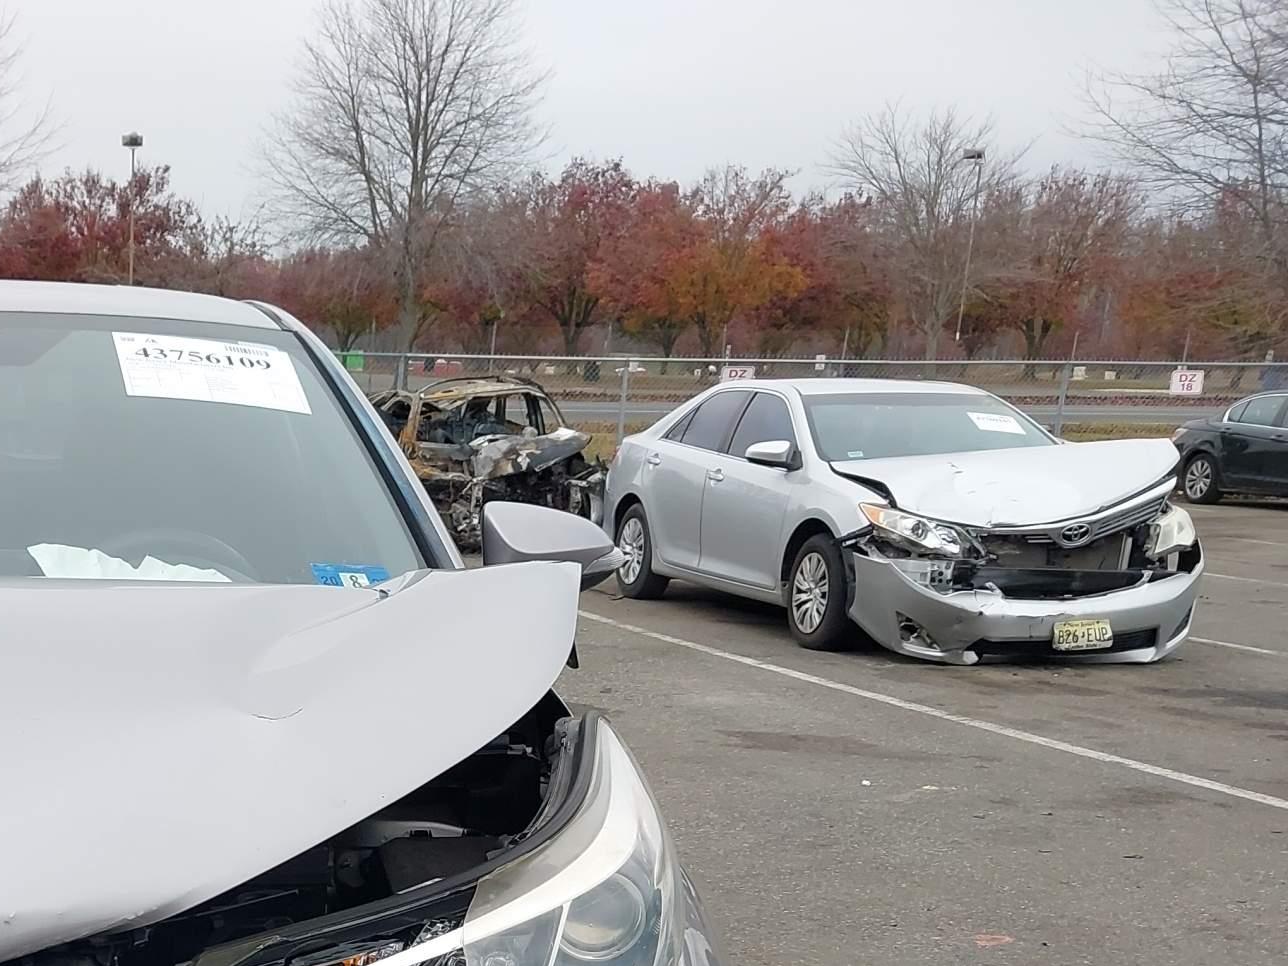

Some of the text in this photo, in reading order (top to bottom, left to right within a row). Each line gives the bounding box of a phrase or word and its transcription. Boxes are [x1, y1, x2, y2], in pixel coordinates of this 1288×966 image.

[135, 347, 272, 370] 43756109
[728, 369, 747, 378] DZ
[1179, 374, 1197, 383] DZ
[1181, 382, 1193, 391] 18
[349, 575, 363, 589] 8
